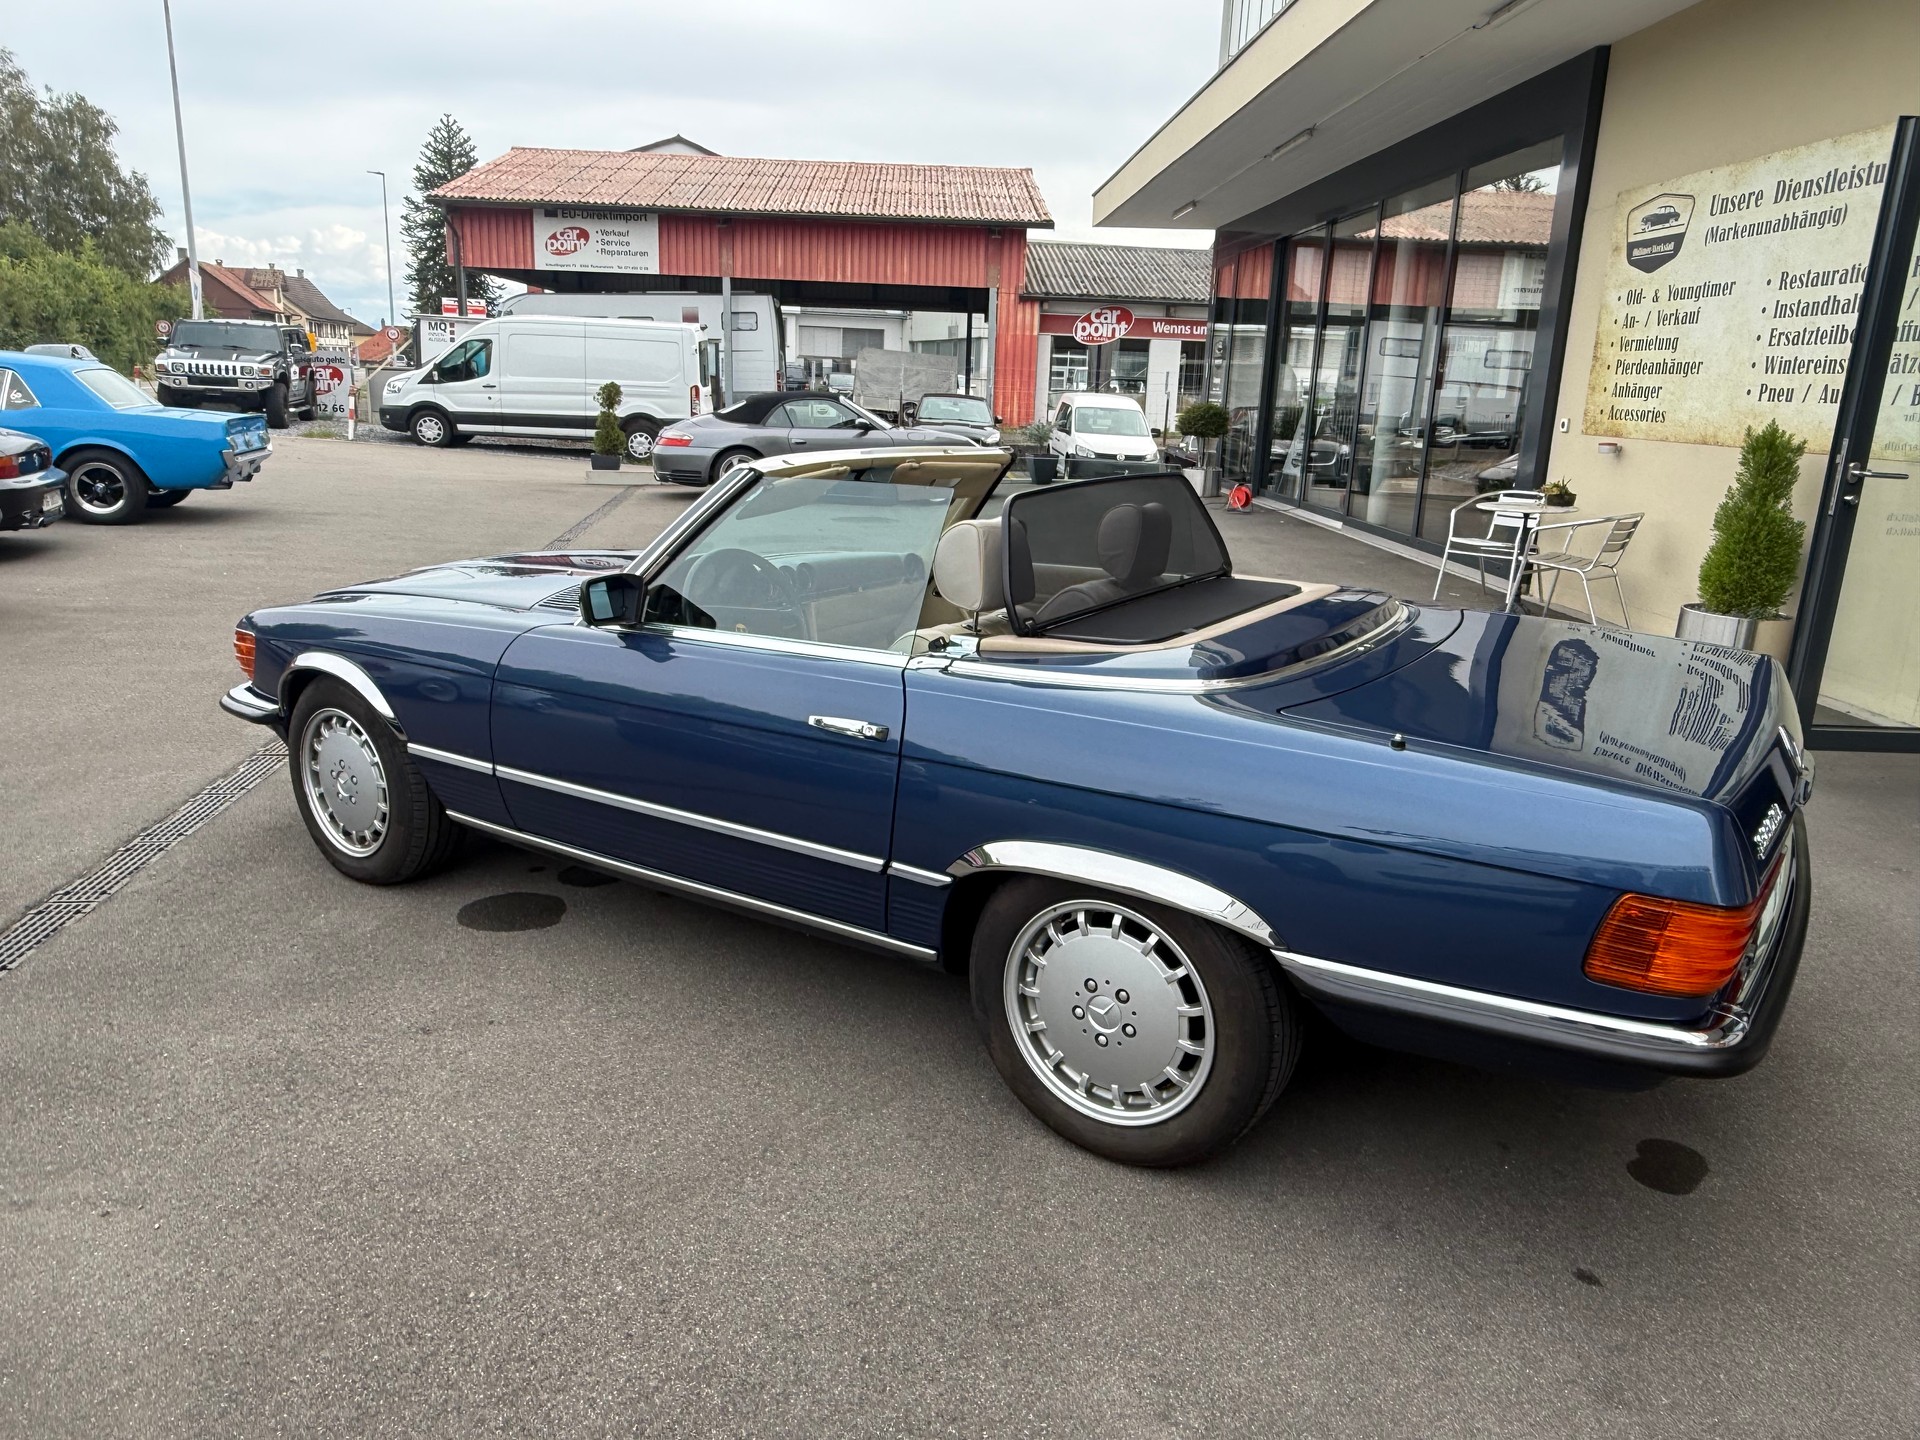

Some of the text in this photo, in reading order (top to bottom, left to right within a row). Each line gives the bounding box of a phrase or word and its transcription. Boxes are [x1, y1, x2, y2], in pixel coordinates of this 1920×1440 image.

[1710, 161, 1887, 217] Unsere Dienstleistu
[1703, 203, 1848, 247] (Markenunabhängig)
[556, 229, 580, 241] car
[600, 229, 630, 238] Verkauf
[547, 238, 587, 252] point
[600, 238, 630, 247] Service
[600, 248, 649, 258] Reparaturen
[1626, 281, 1737, 306] Old- & Youngtimer
[1090, 308, 1121, 323] car
[1621, 307, 1701, 329] An- / Verkauf
[428, 321, 448, 333] MQ
[1077, 321, 1129, 339] point
[1152, 321, 1191, 335] Wenns
[1619, 336, 1680, 353] Vermietung
[315, 367, 333, 380] ar
[1614, 358, 1704, 378] Pferdeanhänger
[1611, 382, 1663, 401] Anhänger
[1758, 383, 1795, 403] Pneu
[1801, 384, 1812, 403] /
[332, 404, 345, 413] 66
[1607, 405, 1666, 423] Accessories
